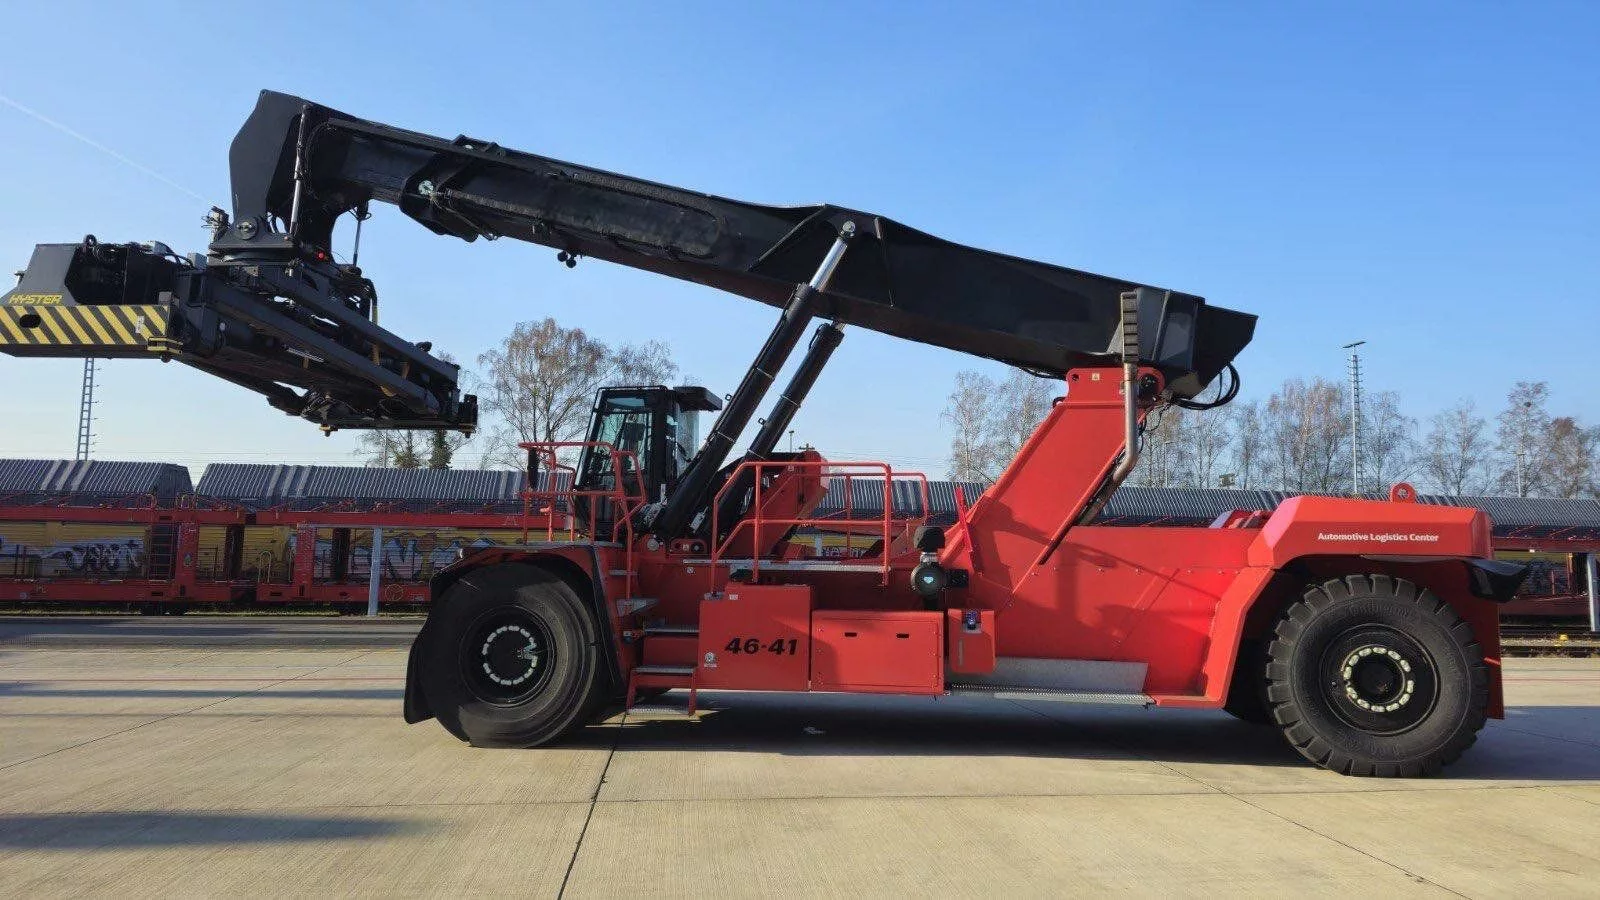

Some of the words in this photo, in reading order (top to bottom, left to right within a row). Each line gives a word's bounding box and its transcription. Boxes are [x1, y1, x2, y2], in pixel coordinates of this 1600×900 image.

[9, 294, 63, 304] HYSTER
[1317, 533, 1368, 541] Automotive
[1370, 533, 1408, 542] Logistics
[1409, 533, 1439, 541] Center
[725, 637, 798, 655] 46-41
